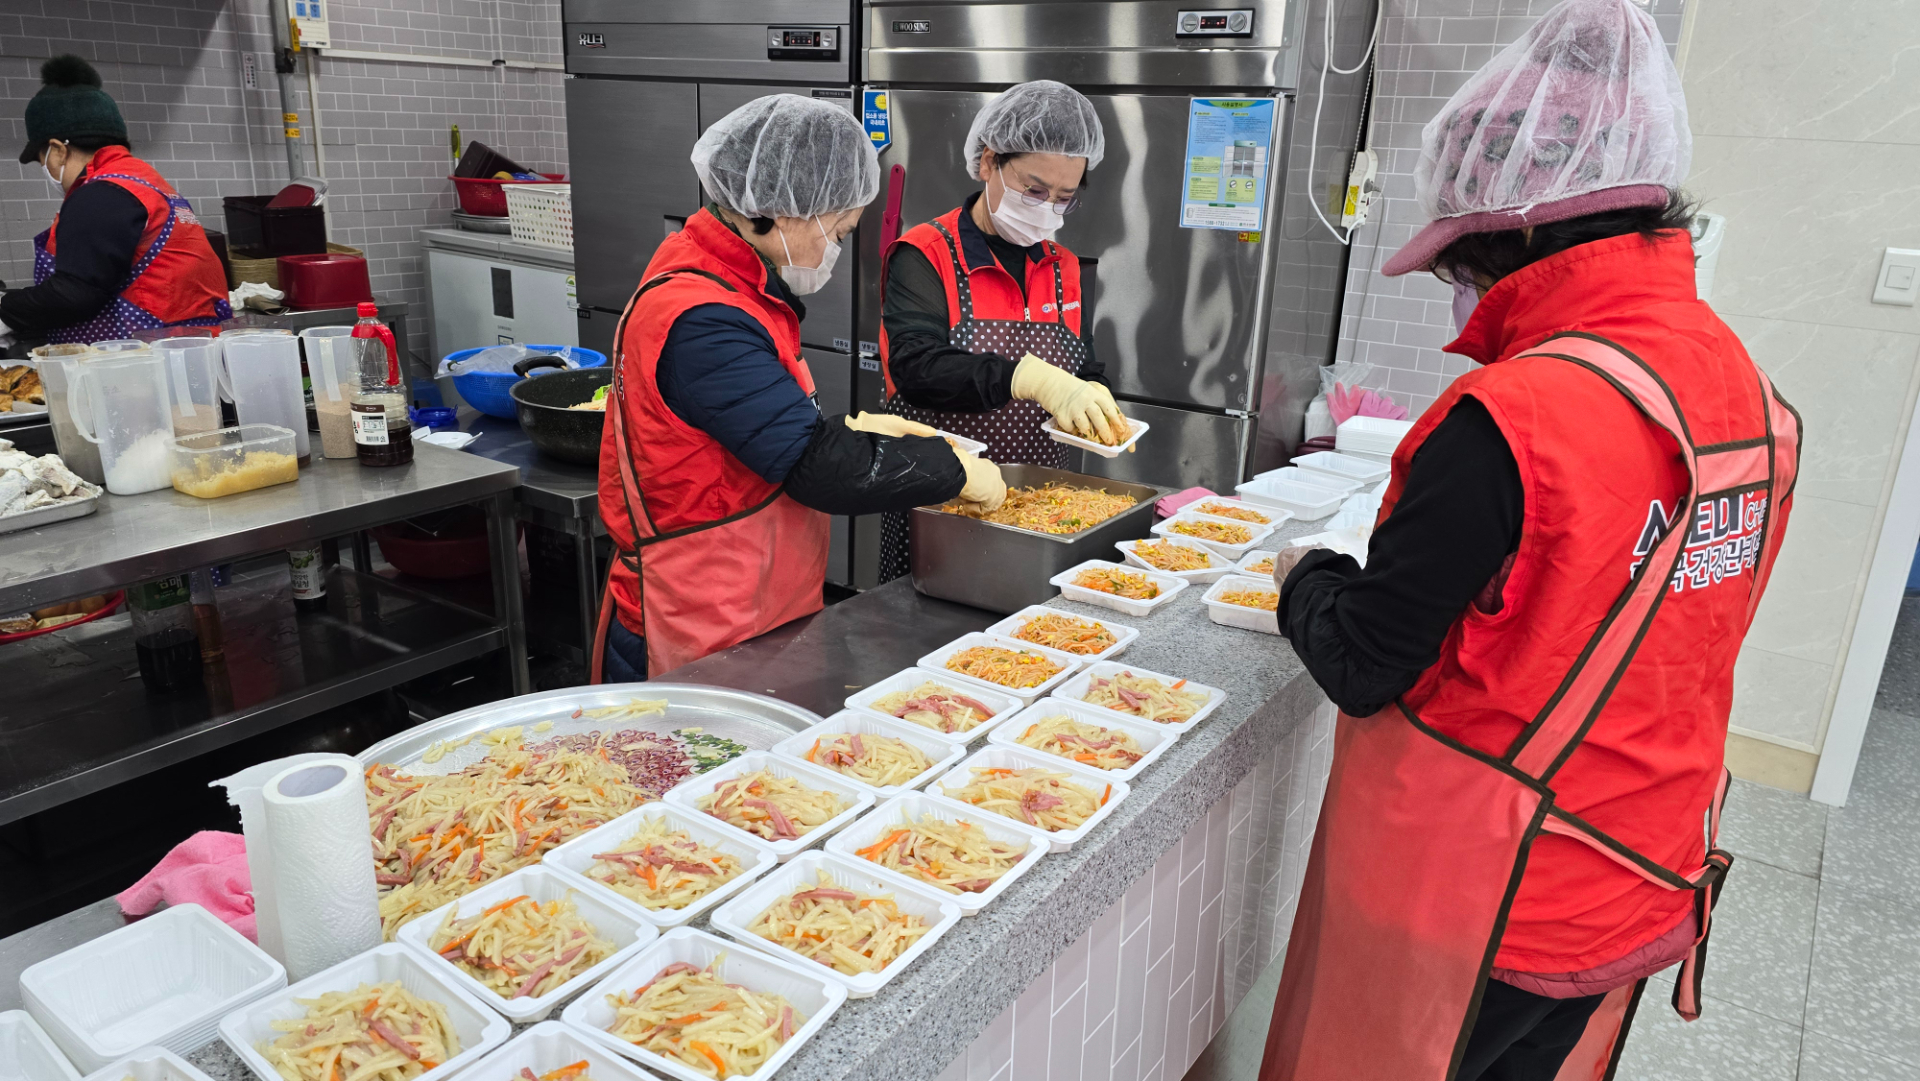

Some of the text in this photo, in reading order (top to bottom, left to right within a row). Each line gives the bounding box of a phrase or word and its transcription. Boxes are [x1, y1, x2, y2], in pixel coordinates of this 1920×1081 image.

[900, 22, 913, 31] WOO
[913, 22, 928, 32] SUNG
[578, 34, 604, 45] 유니크
[834, 340, 848, 348] 냉동실
